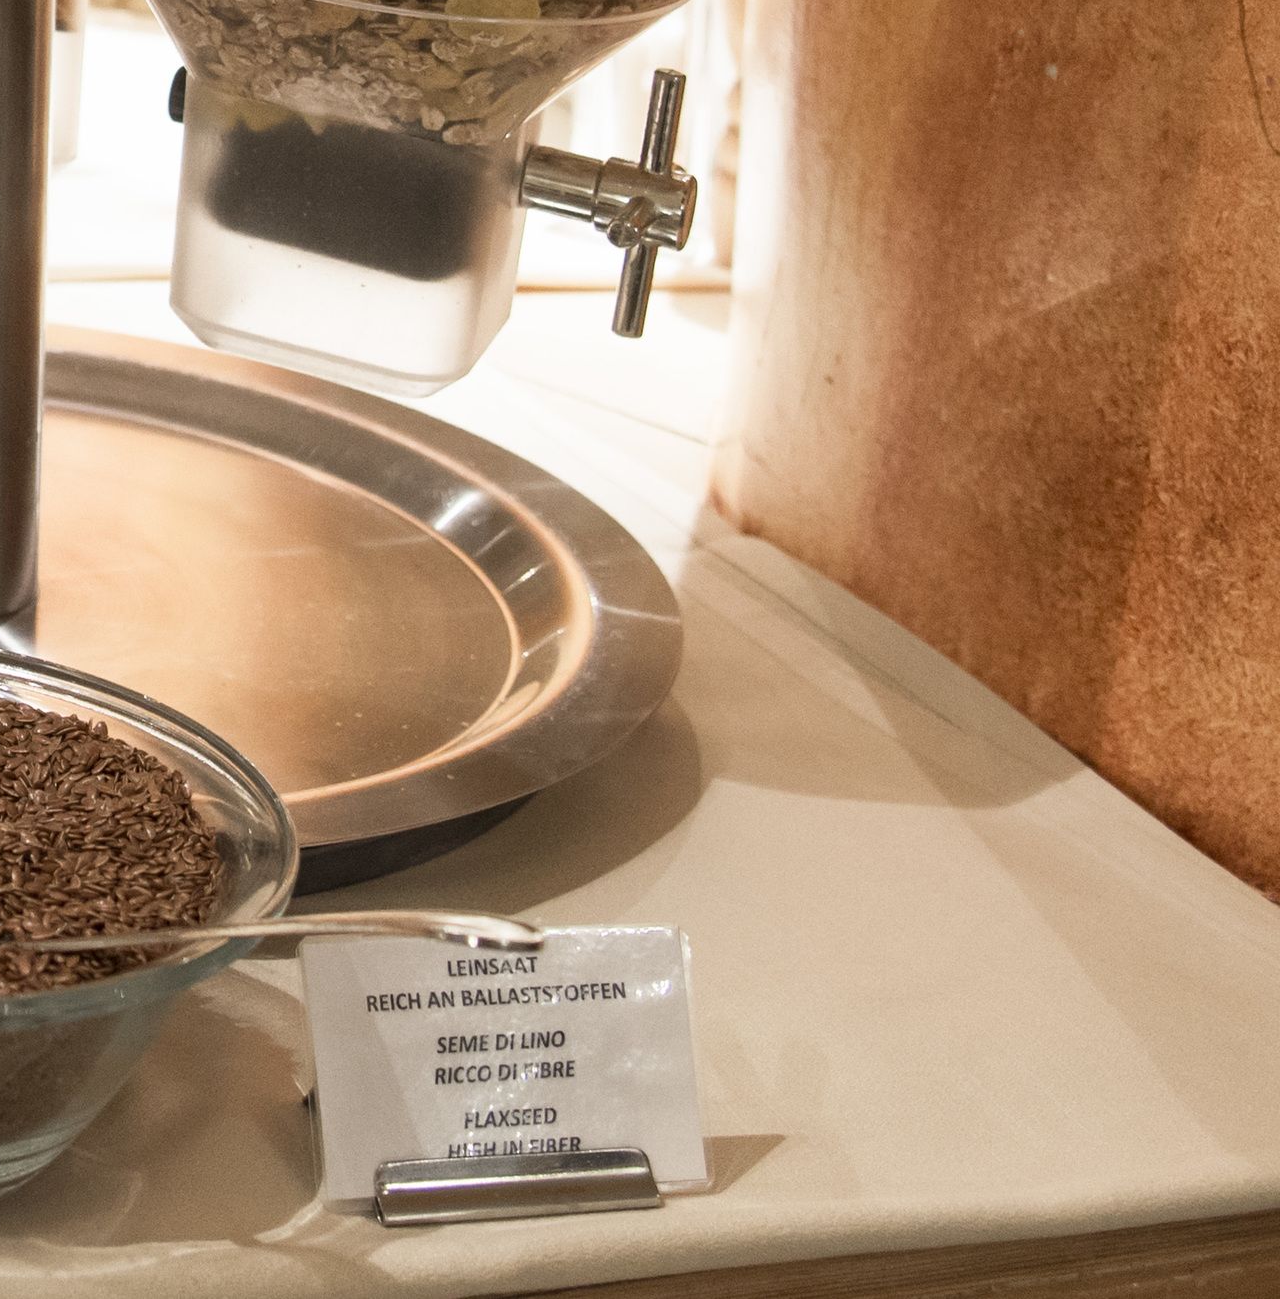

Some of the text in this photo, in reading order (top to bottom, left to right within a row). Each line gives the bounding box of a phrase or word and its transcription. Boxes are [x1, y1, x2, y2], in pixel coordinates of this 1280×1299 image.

[446, 956, 539, 977] LEINSAAT
[366, 982, 627, 1013] REICH AN BALLASTSTOFFEN
[436, 1030, 566, 1055] SEME DI LINO
[434, 1065, 492, 1086] RICCO
[498, 1063, 517, 1082] DI
[464, 1107, 557, 1129] FLAXSEED
